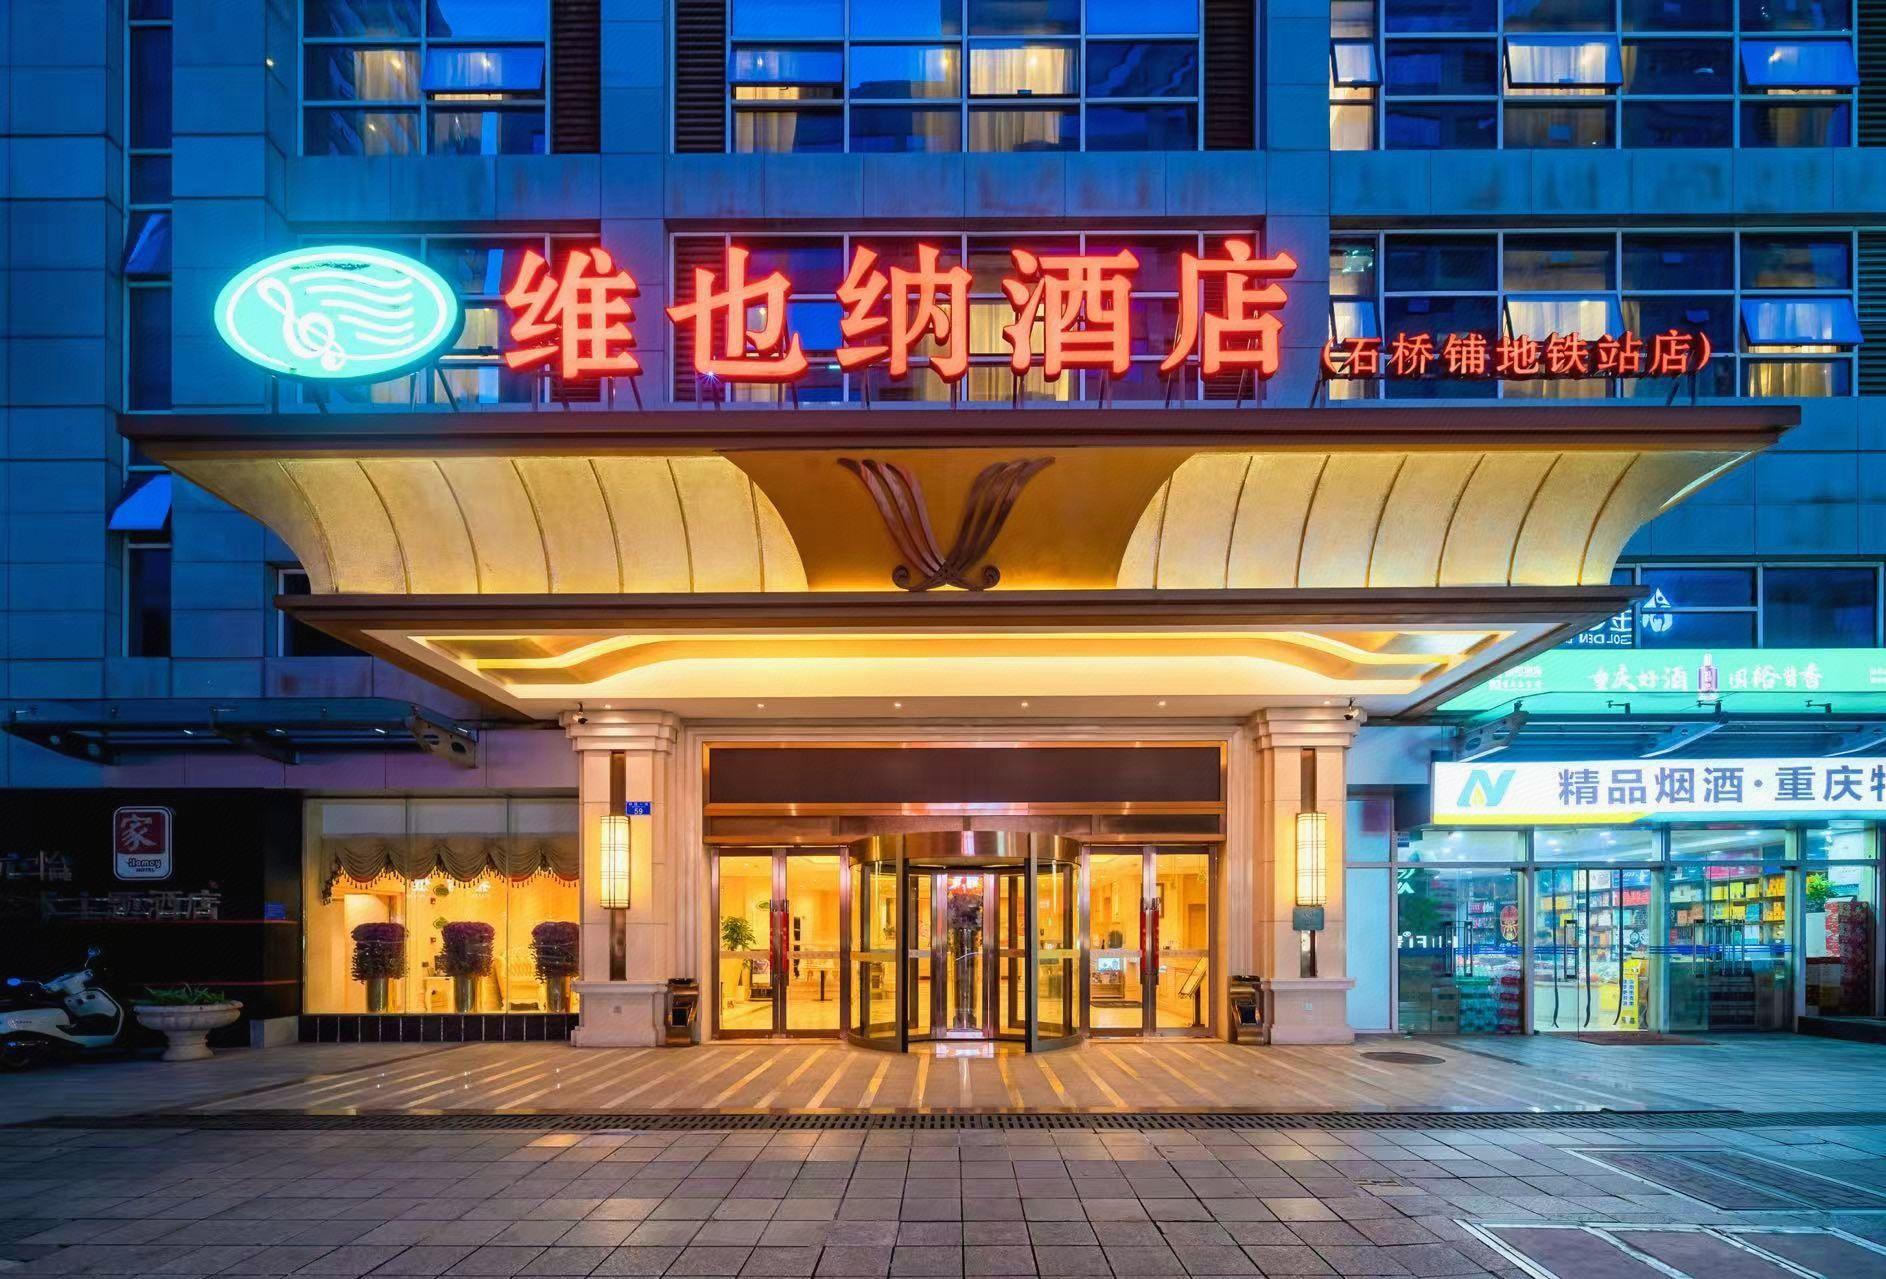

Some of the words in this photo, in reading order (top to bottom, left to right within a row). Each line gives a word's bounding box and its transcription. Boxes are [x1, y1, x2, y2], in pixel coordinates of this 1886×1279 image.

[503, 240, 1297, 381] 维也纳酒店
[1322, 329, 1712, 377] (石桥铺地铁站店)
[120, 813, 157, 852] 家
[634, 807, 643, 815] 59
